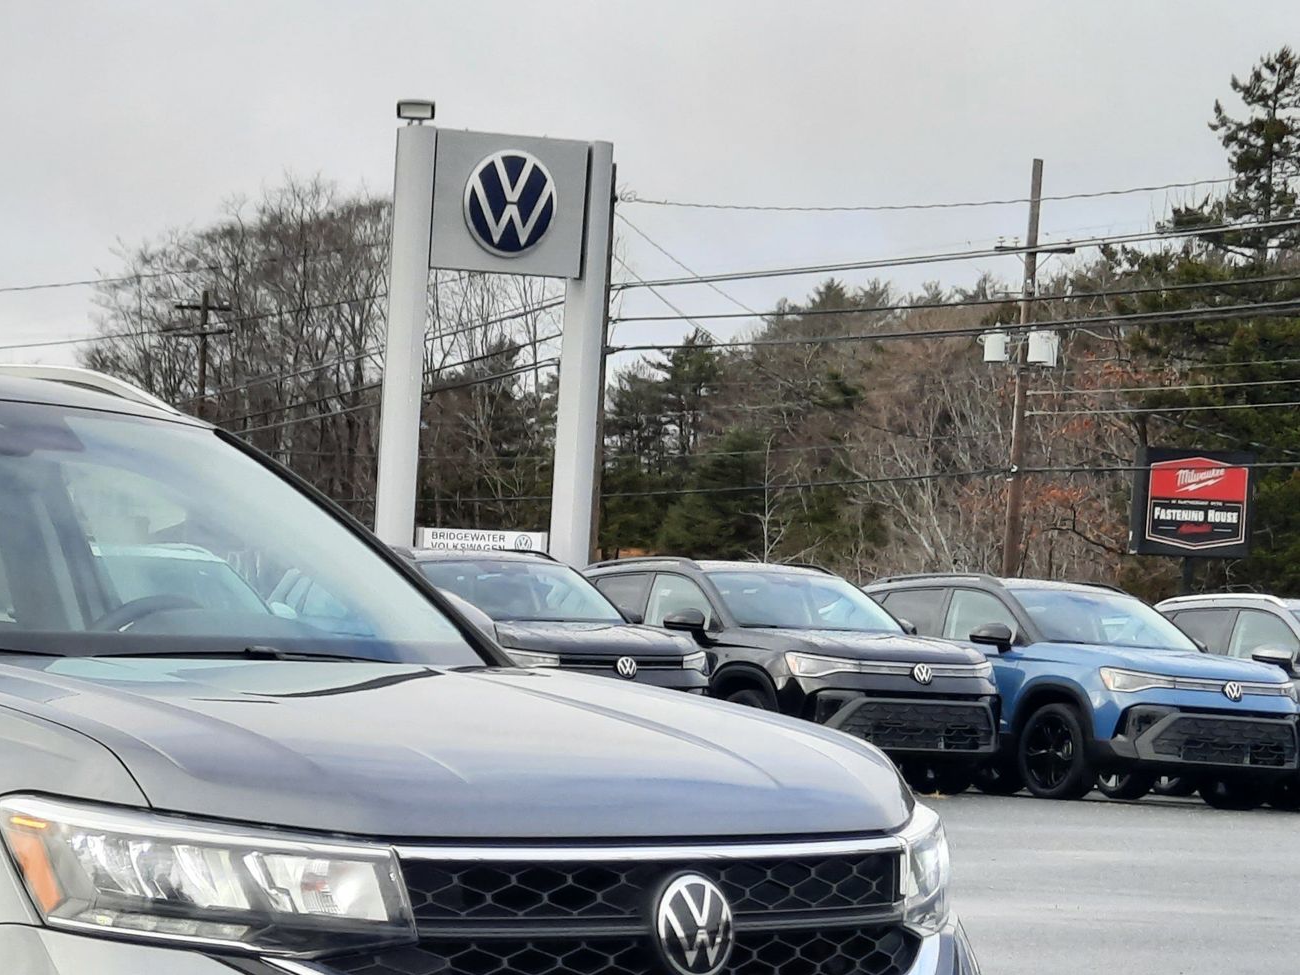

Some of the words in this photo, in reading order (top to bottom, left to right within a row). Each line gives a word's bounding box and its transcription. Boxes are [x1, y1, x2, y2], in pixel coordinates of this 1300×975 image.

[463, 149, 558, 258] VW
[1207, 509, 1239, 524] HOUSE
[431, 531, 506, 543] BRIDGEWATER
[431, 541, 506, 551] VOLKSWAGEN
